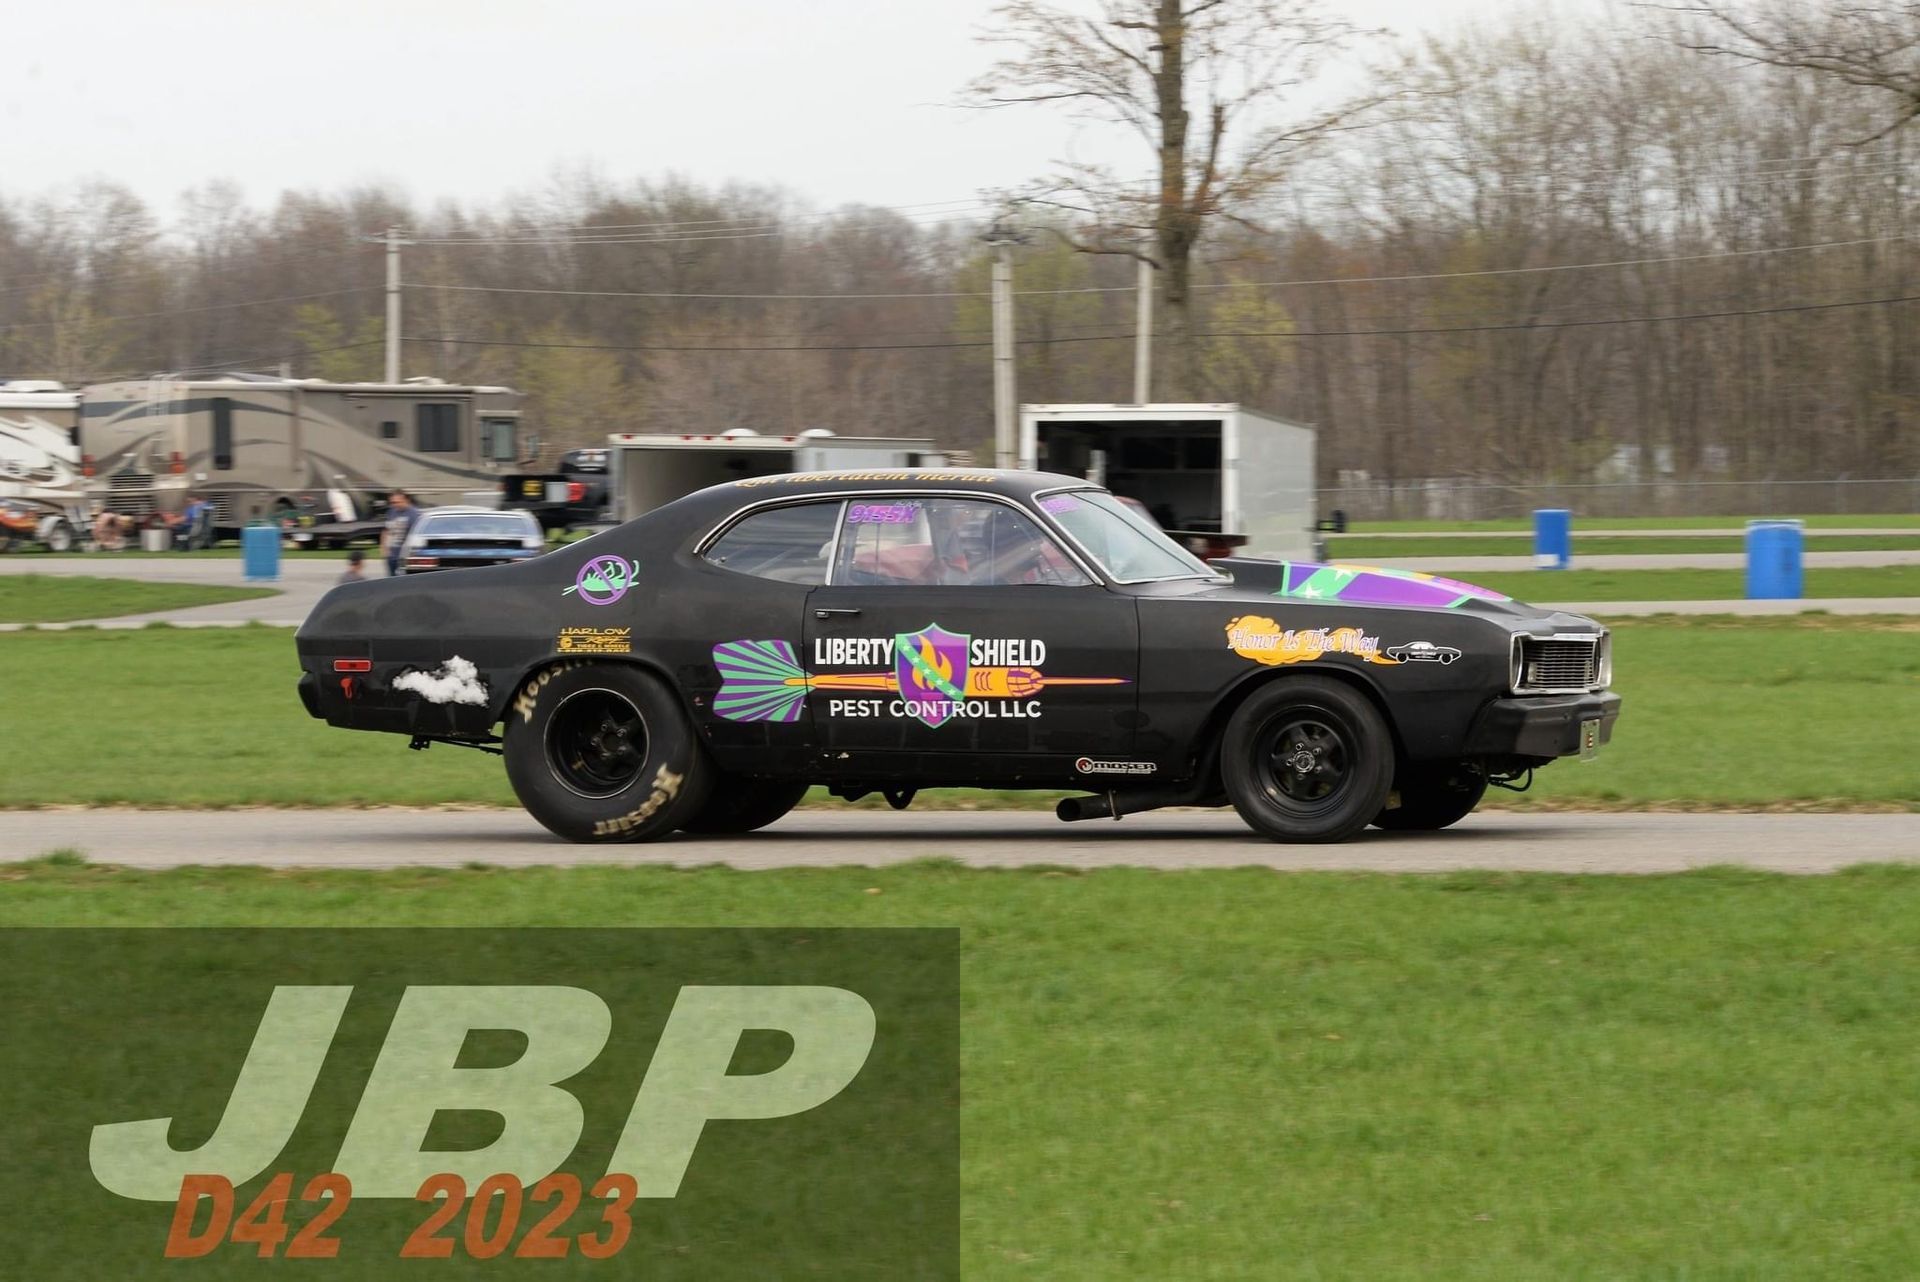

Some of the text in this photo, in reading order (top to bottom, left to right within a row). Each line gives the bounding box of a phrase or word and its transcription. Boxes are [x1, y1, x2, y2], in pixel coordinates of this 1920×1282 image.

[560, 627, 631, 635] HARLOW
[815, 638, 1046, 666] LIBERTY SHIELD
[1227, 625, 1380, 662] Honor Is The Way
[829, 699, 1042, 718] PEST CONTROL LLC
